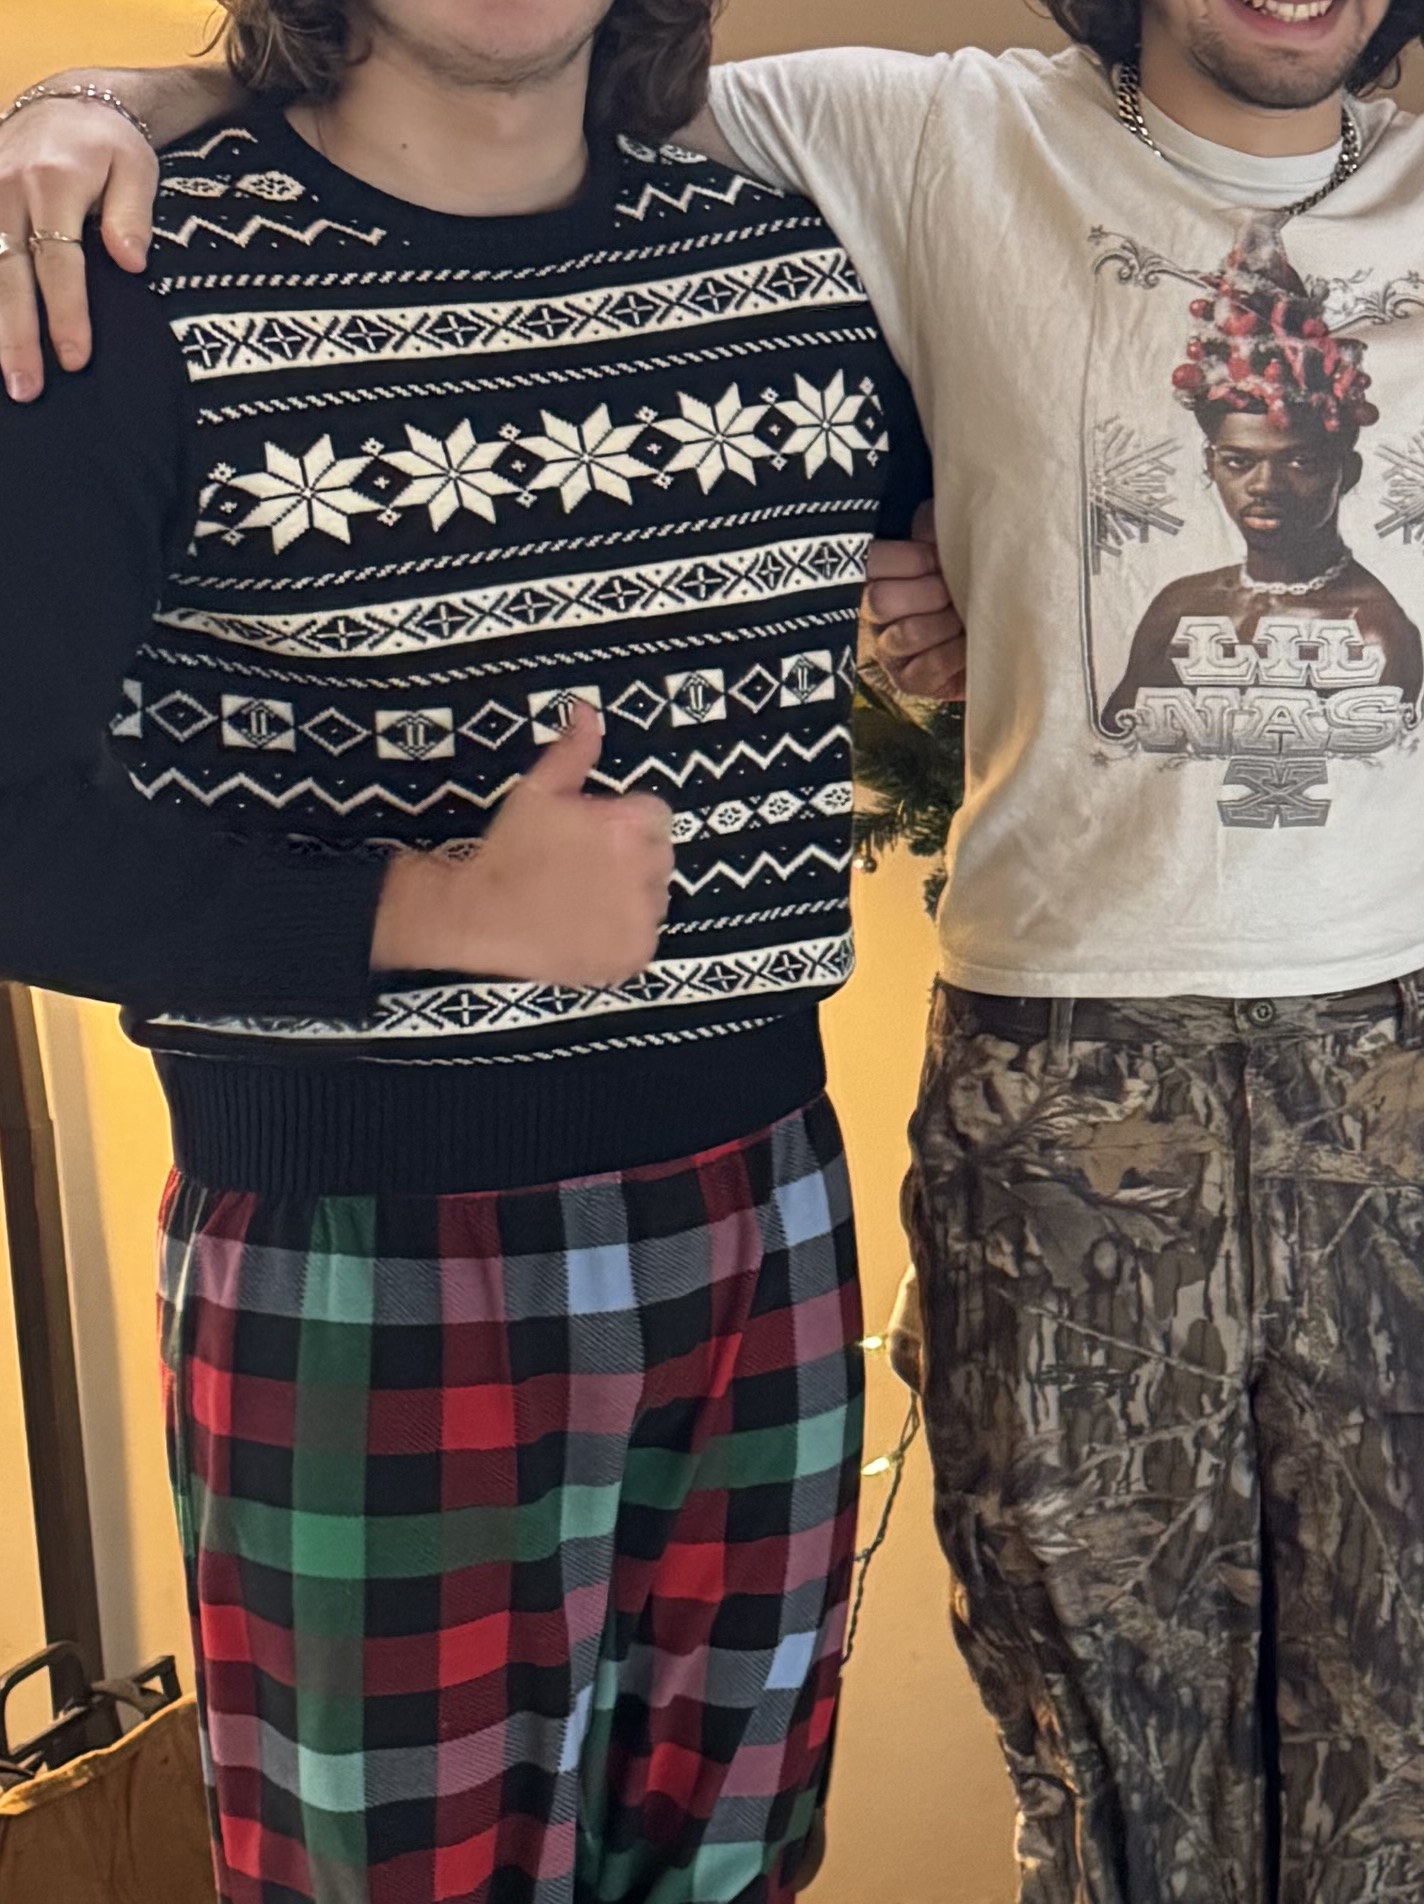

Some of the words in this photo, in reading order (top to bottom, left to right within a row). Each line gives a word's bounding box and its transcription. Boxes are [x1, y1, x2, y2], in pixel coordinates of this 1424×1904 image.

[1170, 616, 1387, 688] LIL
[1134, 686, 1404, 758] NAS
[1216, 756, 1332, 829] X
